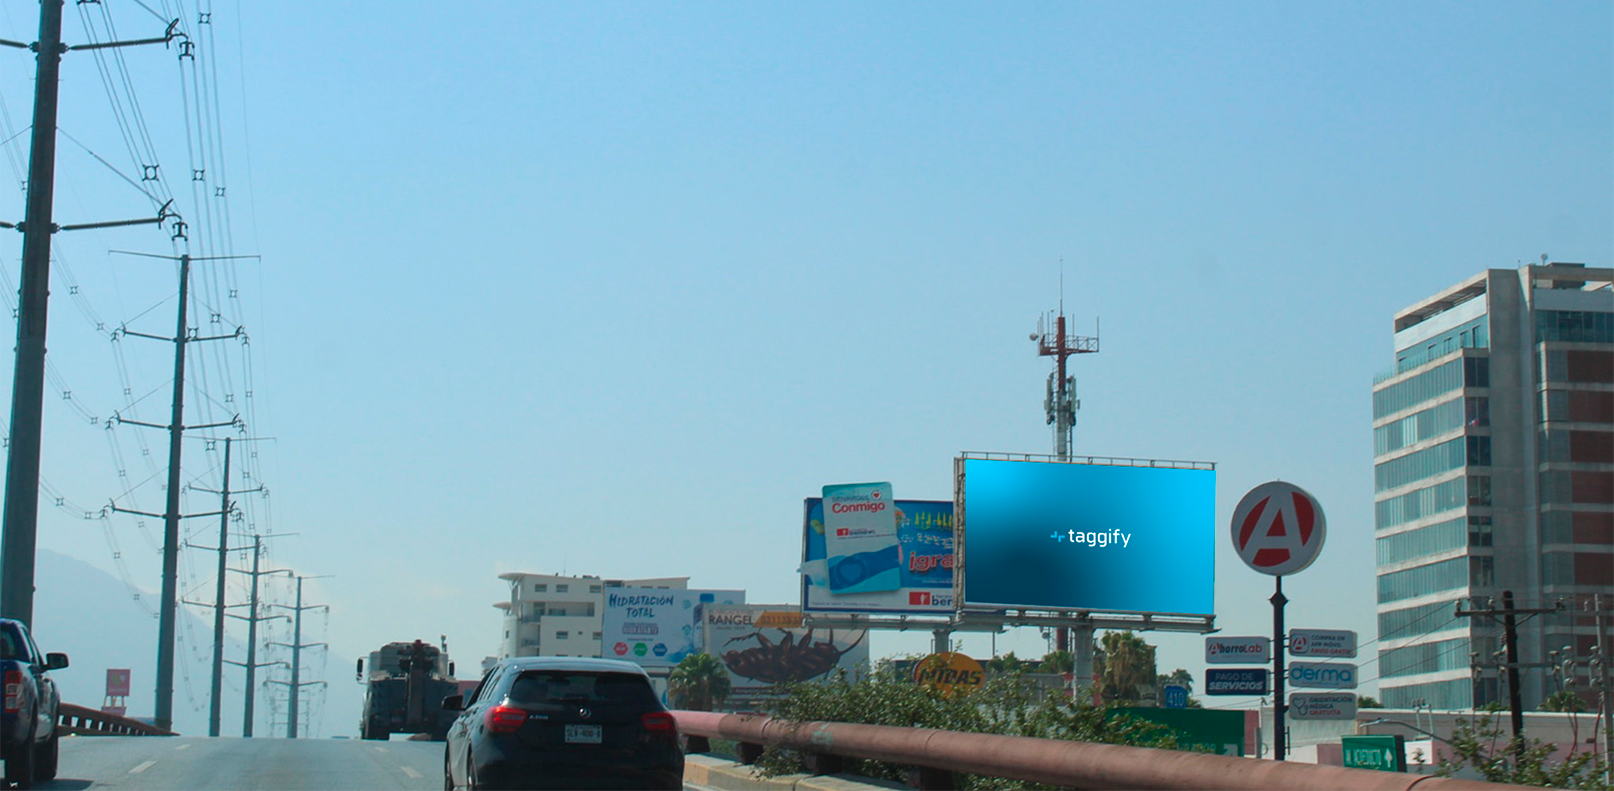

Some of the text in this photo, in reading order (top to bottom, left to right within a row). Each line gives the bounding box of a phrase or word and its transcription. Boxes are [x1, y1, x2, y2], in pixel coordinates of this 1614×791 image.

[832, 501, 886, 514] Conmigo
[1068, 528, 1132, 548] taggify
[609, 593, 674, 608] HIDRATACIÓN
[626, 607, 655, 618] TOTAL
[709, 615, 753, 625] RANGEL
[1209, 643, 1263, 655] AhorroLab
[918, 667, 982, 686] MIDAS
[1215, 673, 1254, 681] PAGO DE
[1291, 665, 1352, 682] derma
[1208, 681, 1264, 691] SERVICIOS
[1168, 692, 1184, 706] 410
